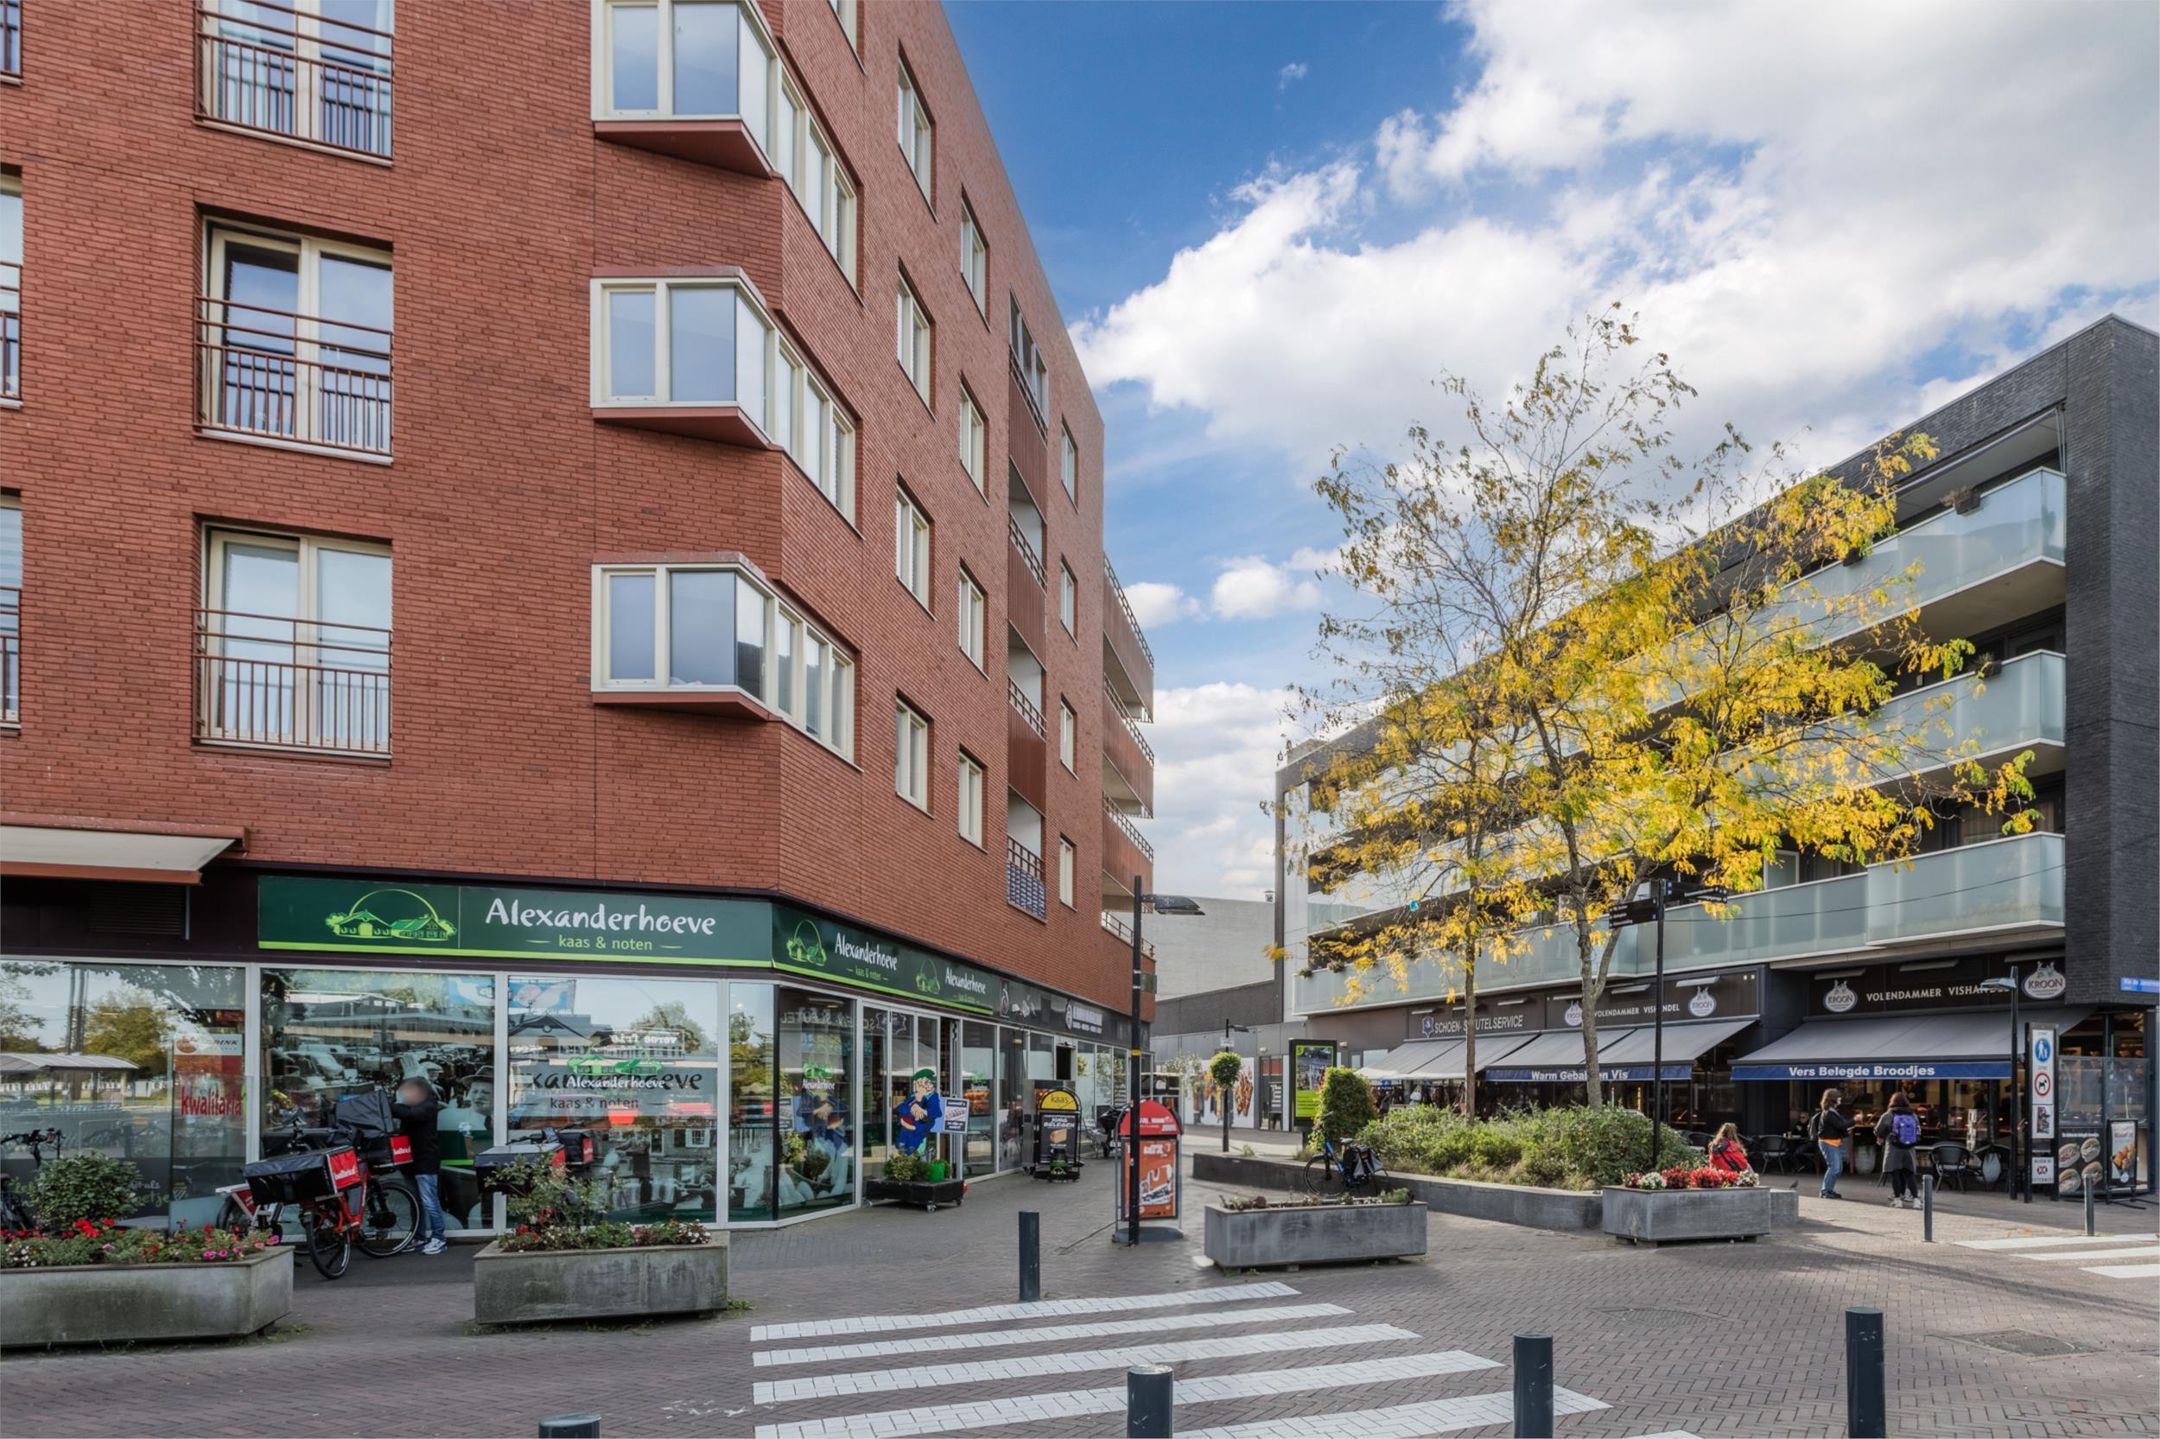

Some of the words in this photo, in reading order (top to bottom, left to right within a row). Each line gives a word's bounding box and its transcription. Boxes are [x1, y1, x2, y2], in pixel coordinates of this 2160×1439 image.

[485, 897, 716, 936] Alexanderhoeve
[558, 935, 590, 949] kaas
[595, 936, 606, 949] &
[612, 937, 653, 951] noten
[834, 932, 898, 972] Alexanderhoeve
[2028, 978, 2063, 989] KROON
[1866, 988, 1942, 1002] VOLENDAMMER
[1643, 1003, 1680, 1014] VISHNDEL
[1463, 1015, 1524, 1033] SUTELSERVICE
[1531, 1071, 1558, 1081] Warm
[1559, 1071, 1608, 1081] Gebaen
[1611, 1070, 1629, 1080] Vis
[1788, 1067, 1816, 1077] Vers
[1819, 1066, 1870, 1078] Belegde
[1874, 1065, 1935, 1078] Broodjes
[566, 1076, 666, 1089] Alexanderhoeve
[181, 1087, 242, 1117] kwalitaria
[550, 1096, 581, 1109] kaas
[599, 1097, 639, 1109] noten
